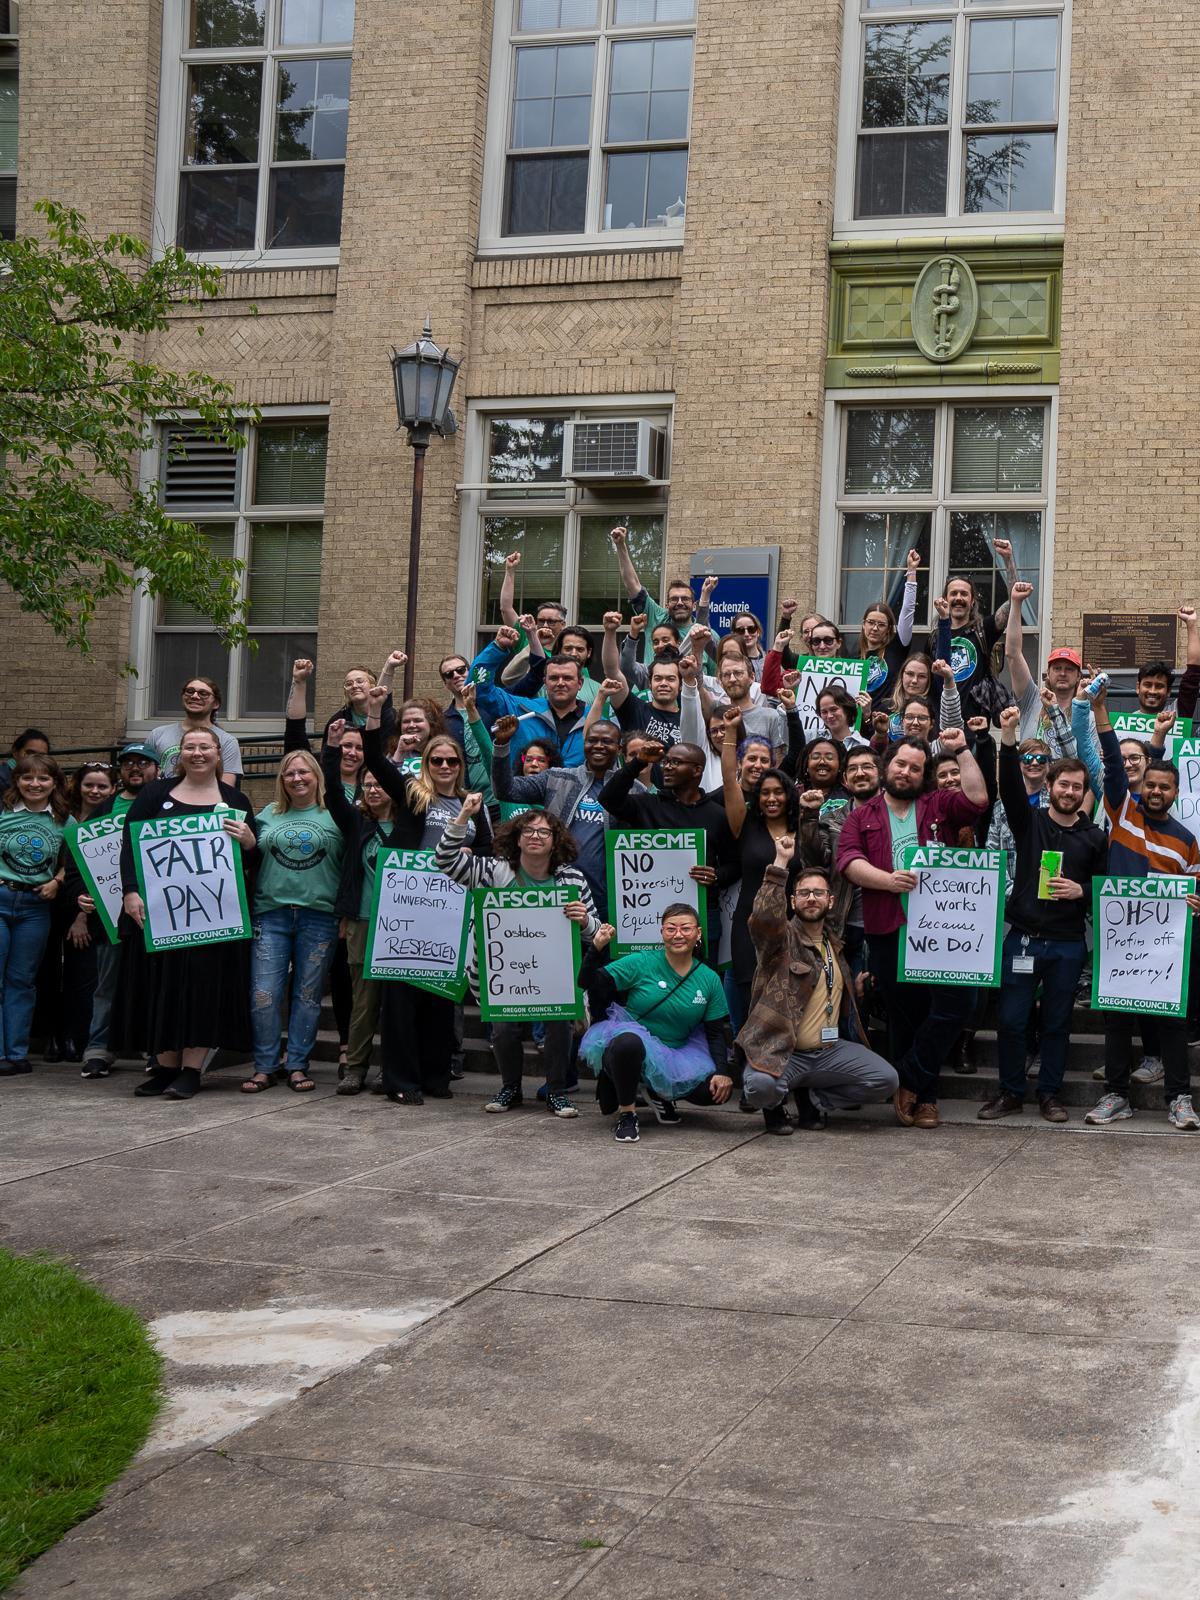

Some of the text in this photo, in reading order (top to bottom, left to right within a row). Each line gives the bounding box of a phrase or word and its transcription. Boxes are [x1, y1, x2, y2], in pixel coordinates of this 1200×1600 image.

[709, 601, 750, 613] Mackenzie
[719, 616, 735, 628] Hal
[803, 659, 864, 675] AFSCME
[1113, 716, 1184, 735] AFSCE
[77, 814, 127, 844] AFSC
[614, 833, 696, 849] AFSCME
[146, 836, 232, 877] FAIR
[384, 850, 437, 871] AFSC
[621, 853, 654, 876] NO
[910, 849, 1000, 868] AFSCME
[386, 872, 465, 895] 8-10 YEARS
[621, 875, 685, 893] Diversity
[919, 871, 991, 896] Research
[1100, 878, 1189, 898] AFSCME
[163, 878, 225, 931] PAY
[483, 890, 569, 908] AFSCME
[622, 893, 652, 909] NO
[1105, 900, 1170, 926] OHSU
[378, 916, 415, 932] NOT
[621, 911, 663, 936] Equit
[918, 914, 975, 931] because
[152, 934, 192, 946] OREGON
[192, 929, 232, 940] COUNCIL
[947, 933, 984, 953] Do!
[1153, 931, 1175, 946] off
[386, 936, 457, 960] RESPECTED
[1125, 952, 1149, 961] our
[370, 967, 407, 976] OREGON
[408, 969, 445, 978] COUNCIL
[904, 969, 942, 979] OREGON
[943, 971, 981, 981] COUNCIL
[982, 973, 994, 981] 75
[1097, 996, 1133, 1006] OREGON
[1134, 999, 1168, 1010] COUNCIL
[1170, 1003, 1181, 1011] 75
